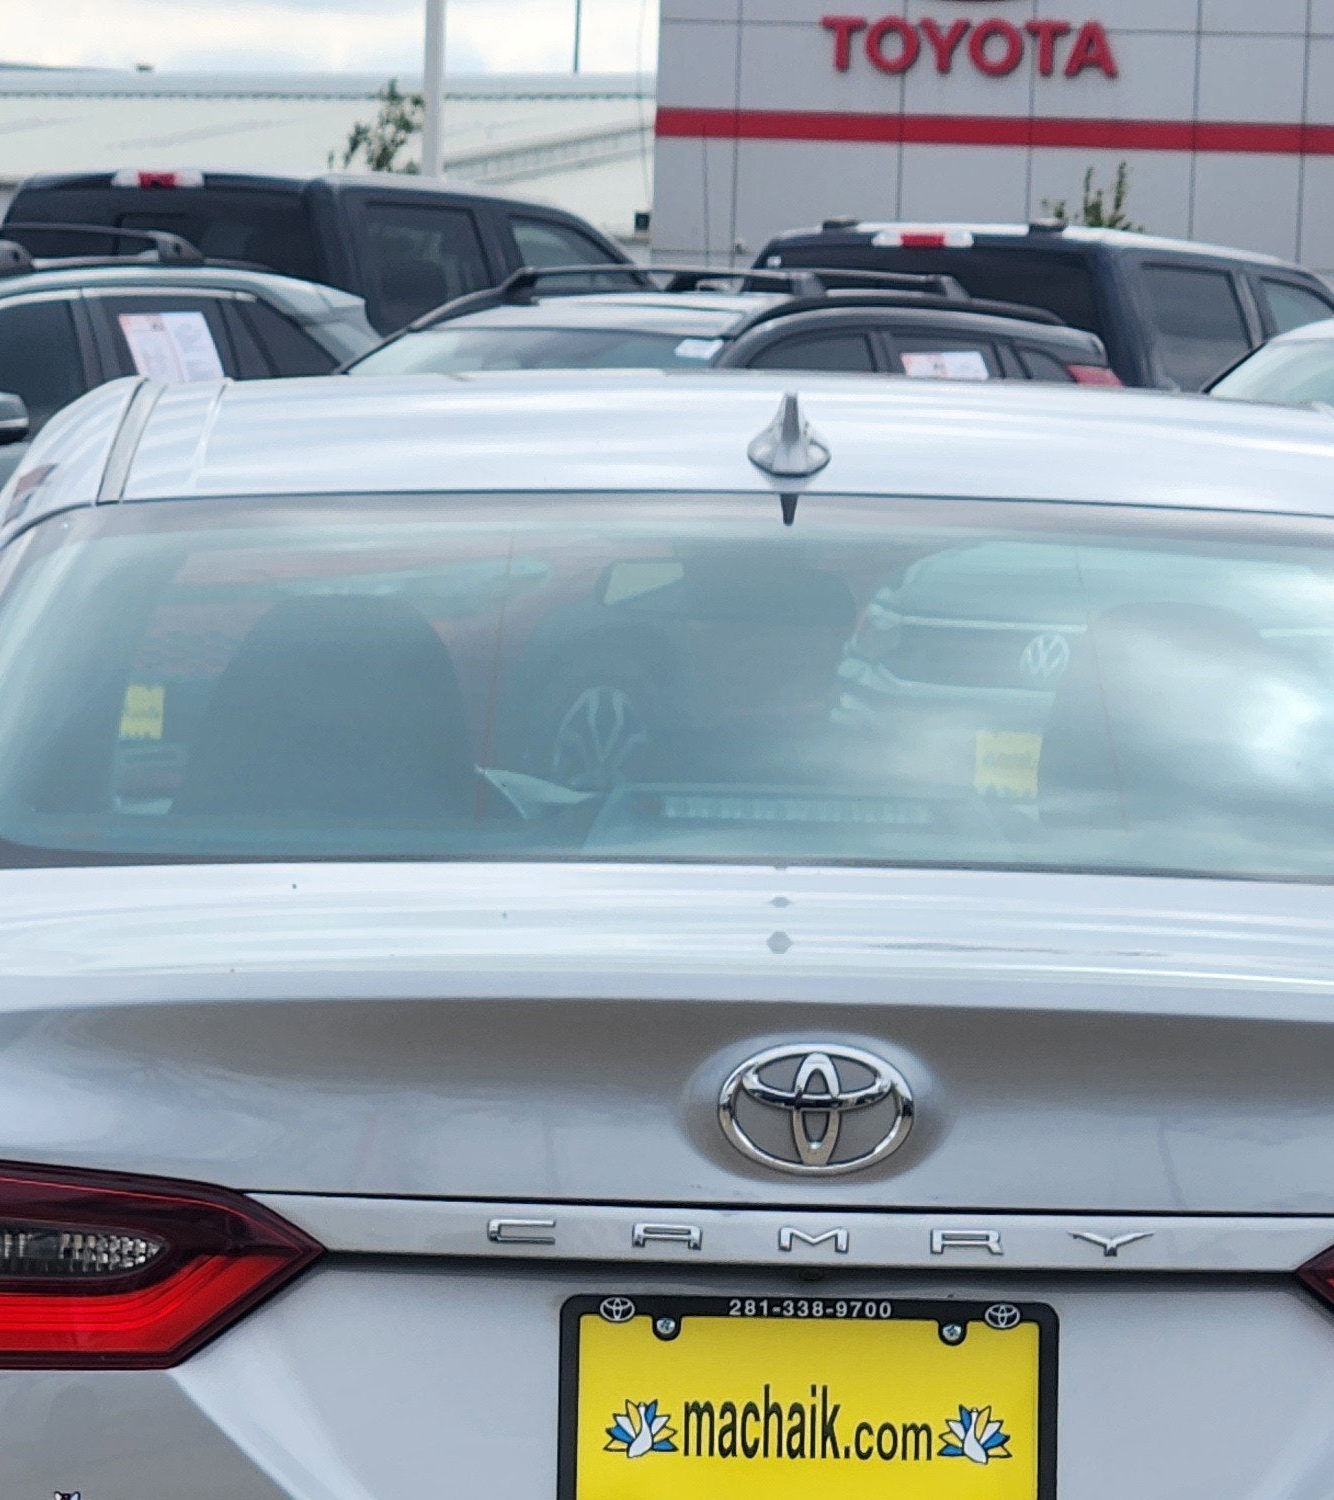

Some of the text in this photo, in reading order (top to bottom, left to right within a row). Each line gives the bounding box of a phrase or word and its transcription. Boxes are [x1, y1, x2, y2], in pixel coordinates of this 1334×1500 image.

[821, 15, 1119, 78] TOYOTA
[486, 1217, 1155, 1258] CAMRY
[729, 1299, 893, 1318] 281-338-9700
[682, 1384, 933, 1461] machaik.com
